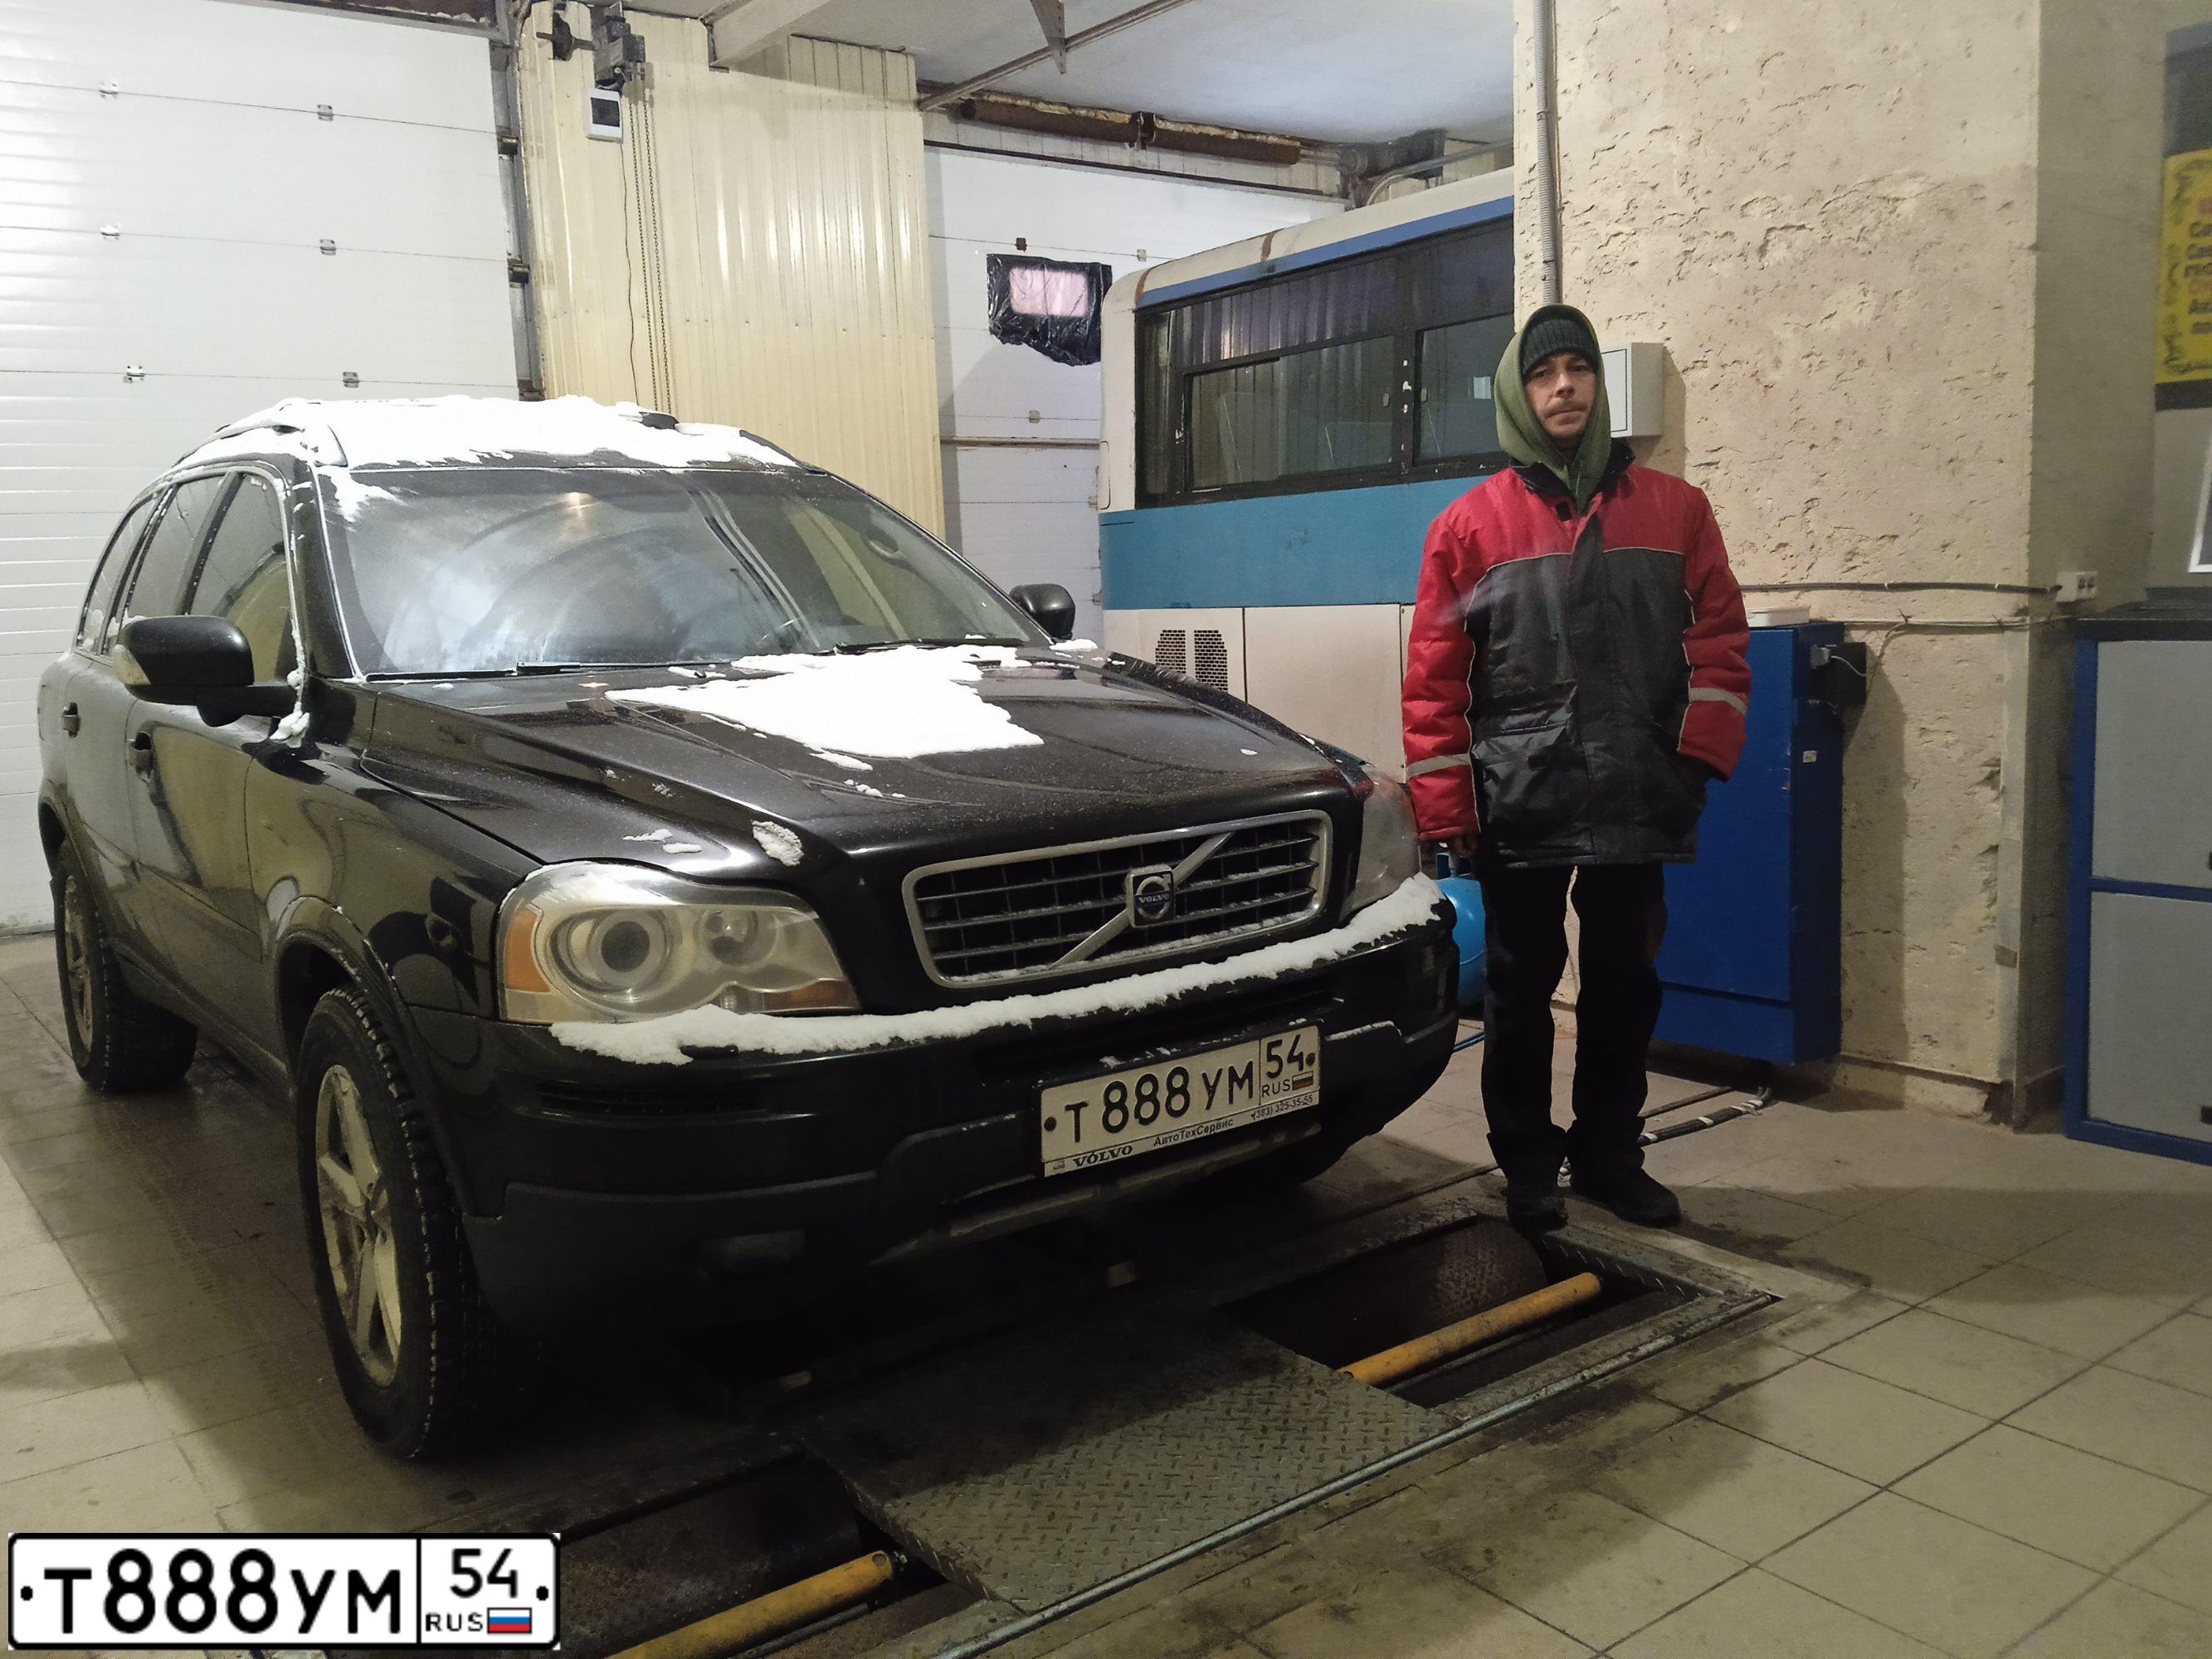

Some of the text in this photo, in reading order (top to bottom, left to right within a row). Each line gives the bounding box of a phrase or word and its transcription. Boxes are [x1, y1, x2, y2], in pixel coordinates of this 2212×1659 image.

[1139, 894, 1169, 903] VOLVO
[1065, 1034, 1304, 1143] Т888УМ 54
[1261, 1078, 1291, 1098] RUS
[1072, 1145, 1133, 1167] VOLVO
[1153, 1118, 1235, 1147] АвтоТехСервис
